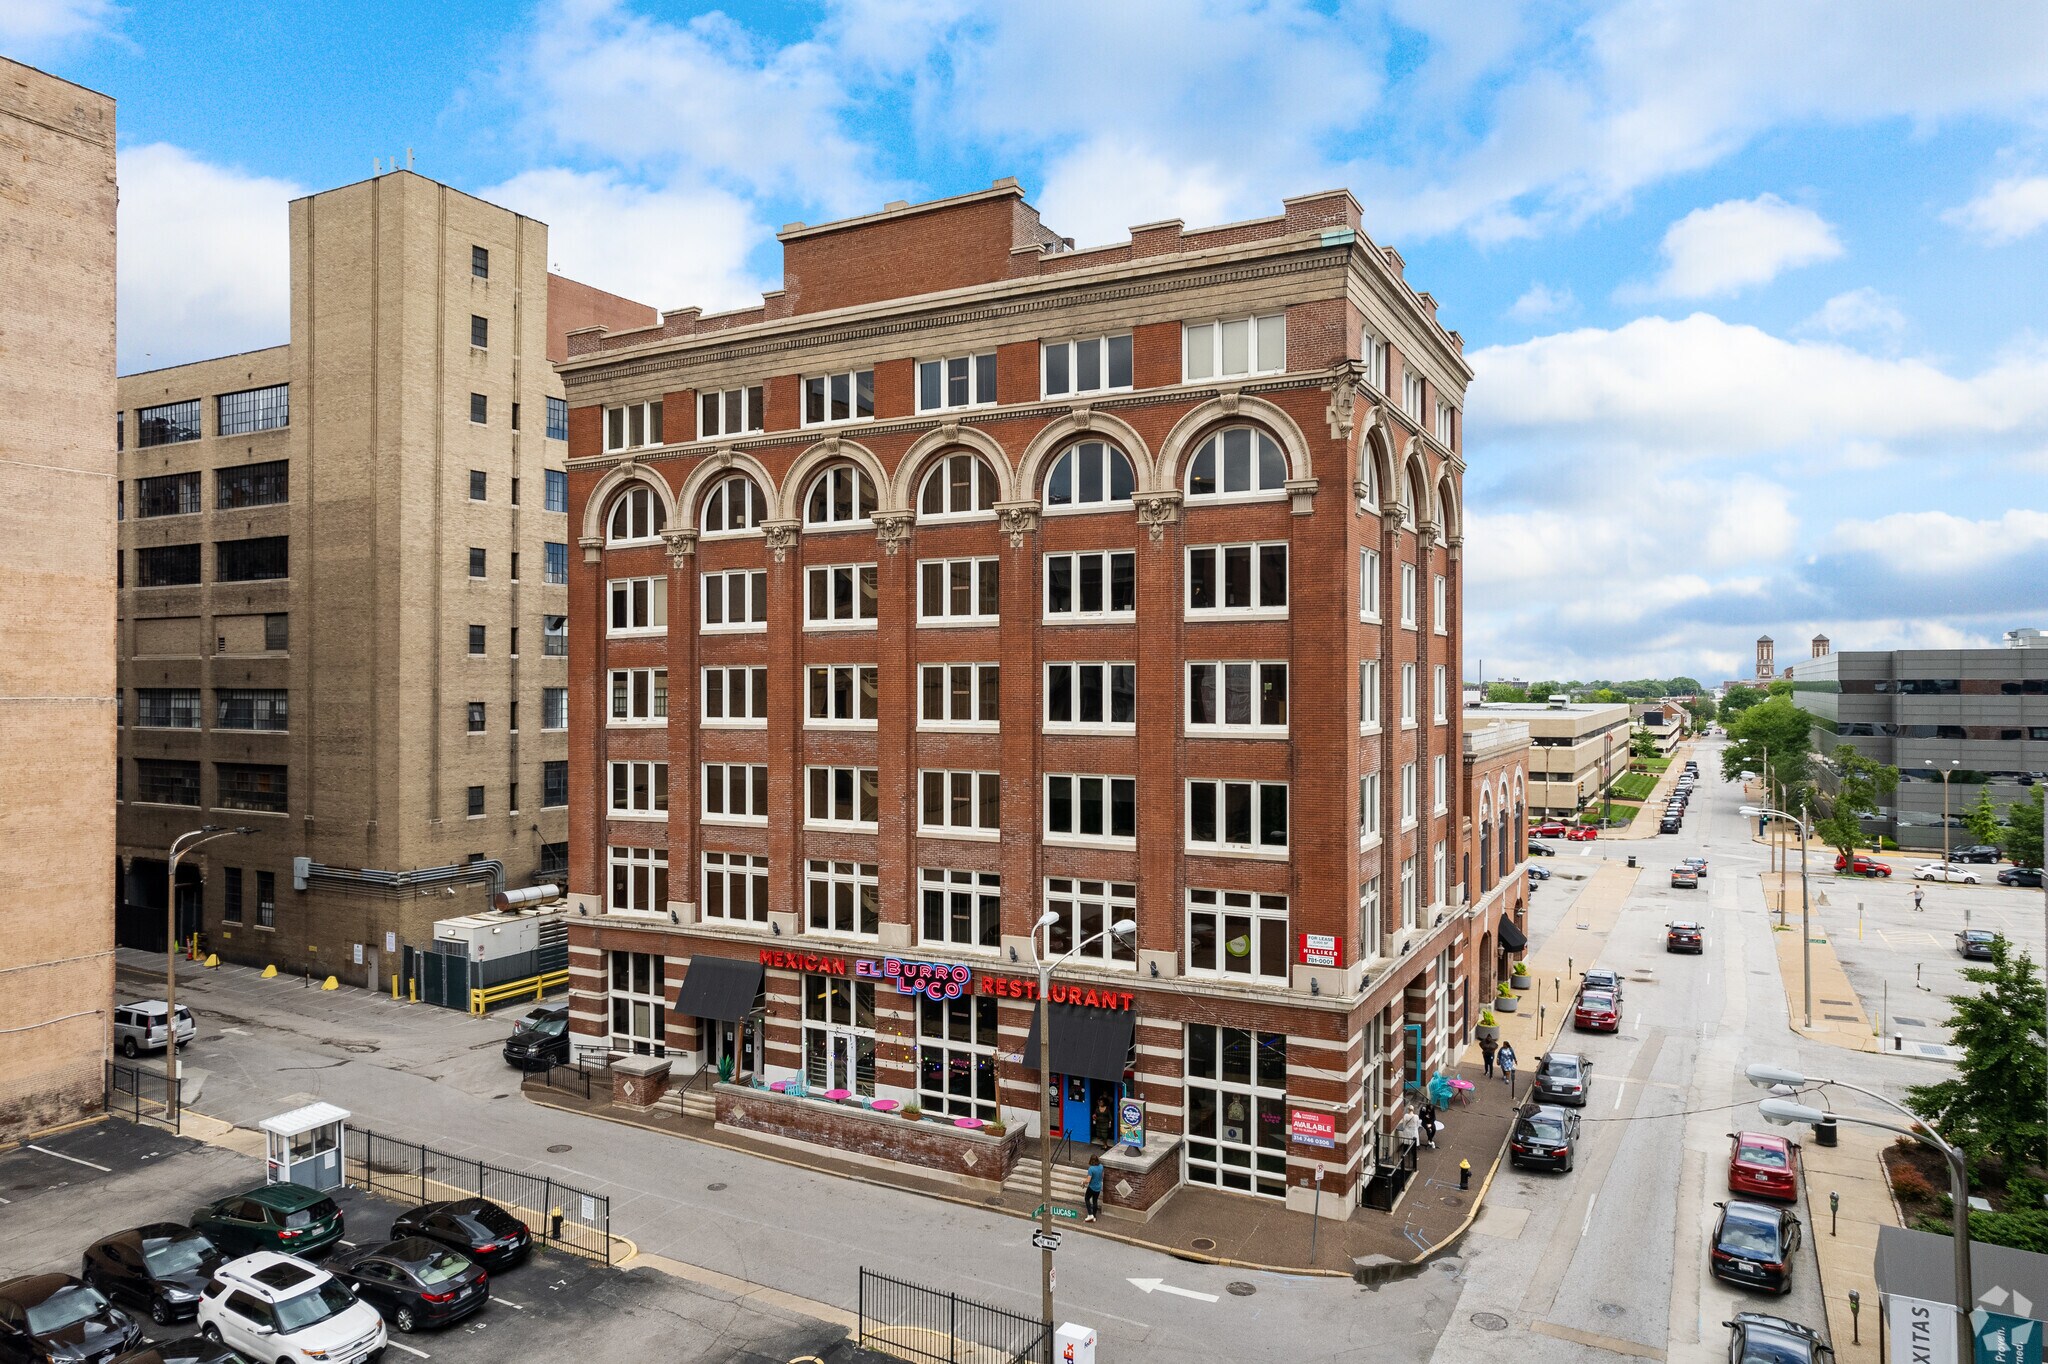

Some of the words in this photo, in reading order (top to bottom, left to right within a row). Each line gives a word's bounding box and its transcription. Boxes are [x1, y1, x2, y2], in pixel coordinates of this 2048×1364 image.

[1303, 948, 1338, 956] HILLIKER
[760, 949, 846, 975] MEXICAN
[857, 961, 882, 976] EL
[886, 959, 968, 983] BURRO
[899, 976, 960, 999] LOCO
[1293, 1121, 1331, 1132] AVAILABLE
[1053, 1207, 1072, 1217] LUCAS
[549, 1279, 567, 1290] 17
[465, 1322, 487, 1334] 18
[1911, 1306, 1930, 1364] XITAS
